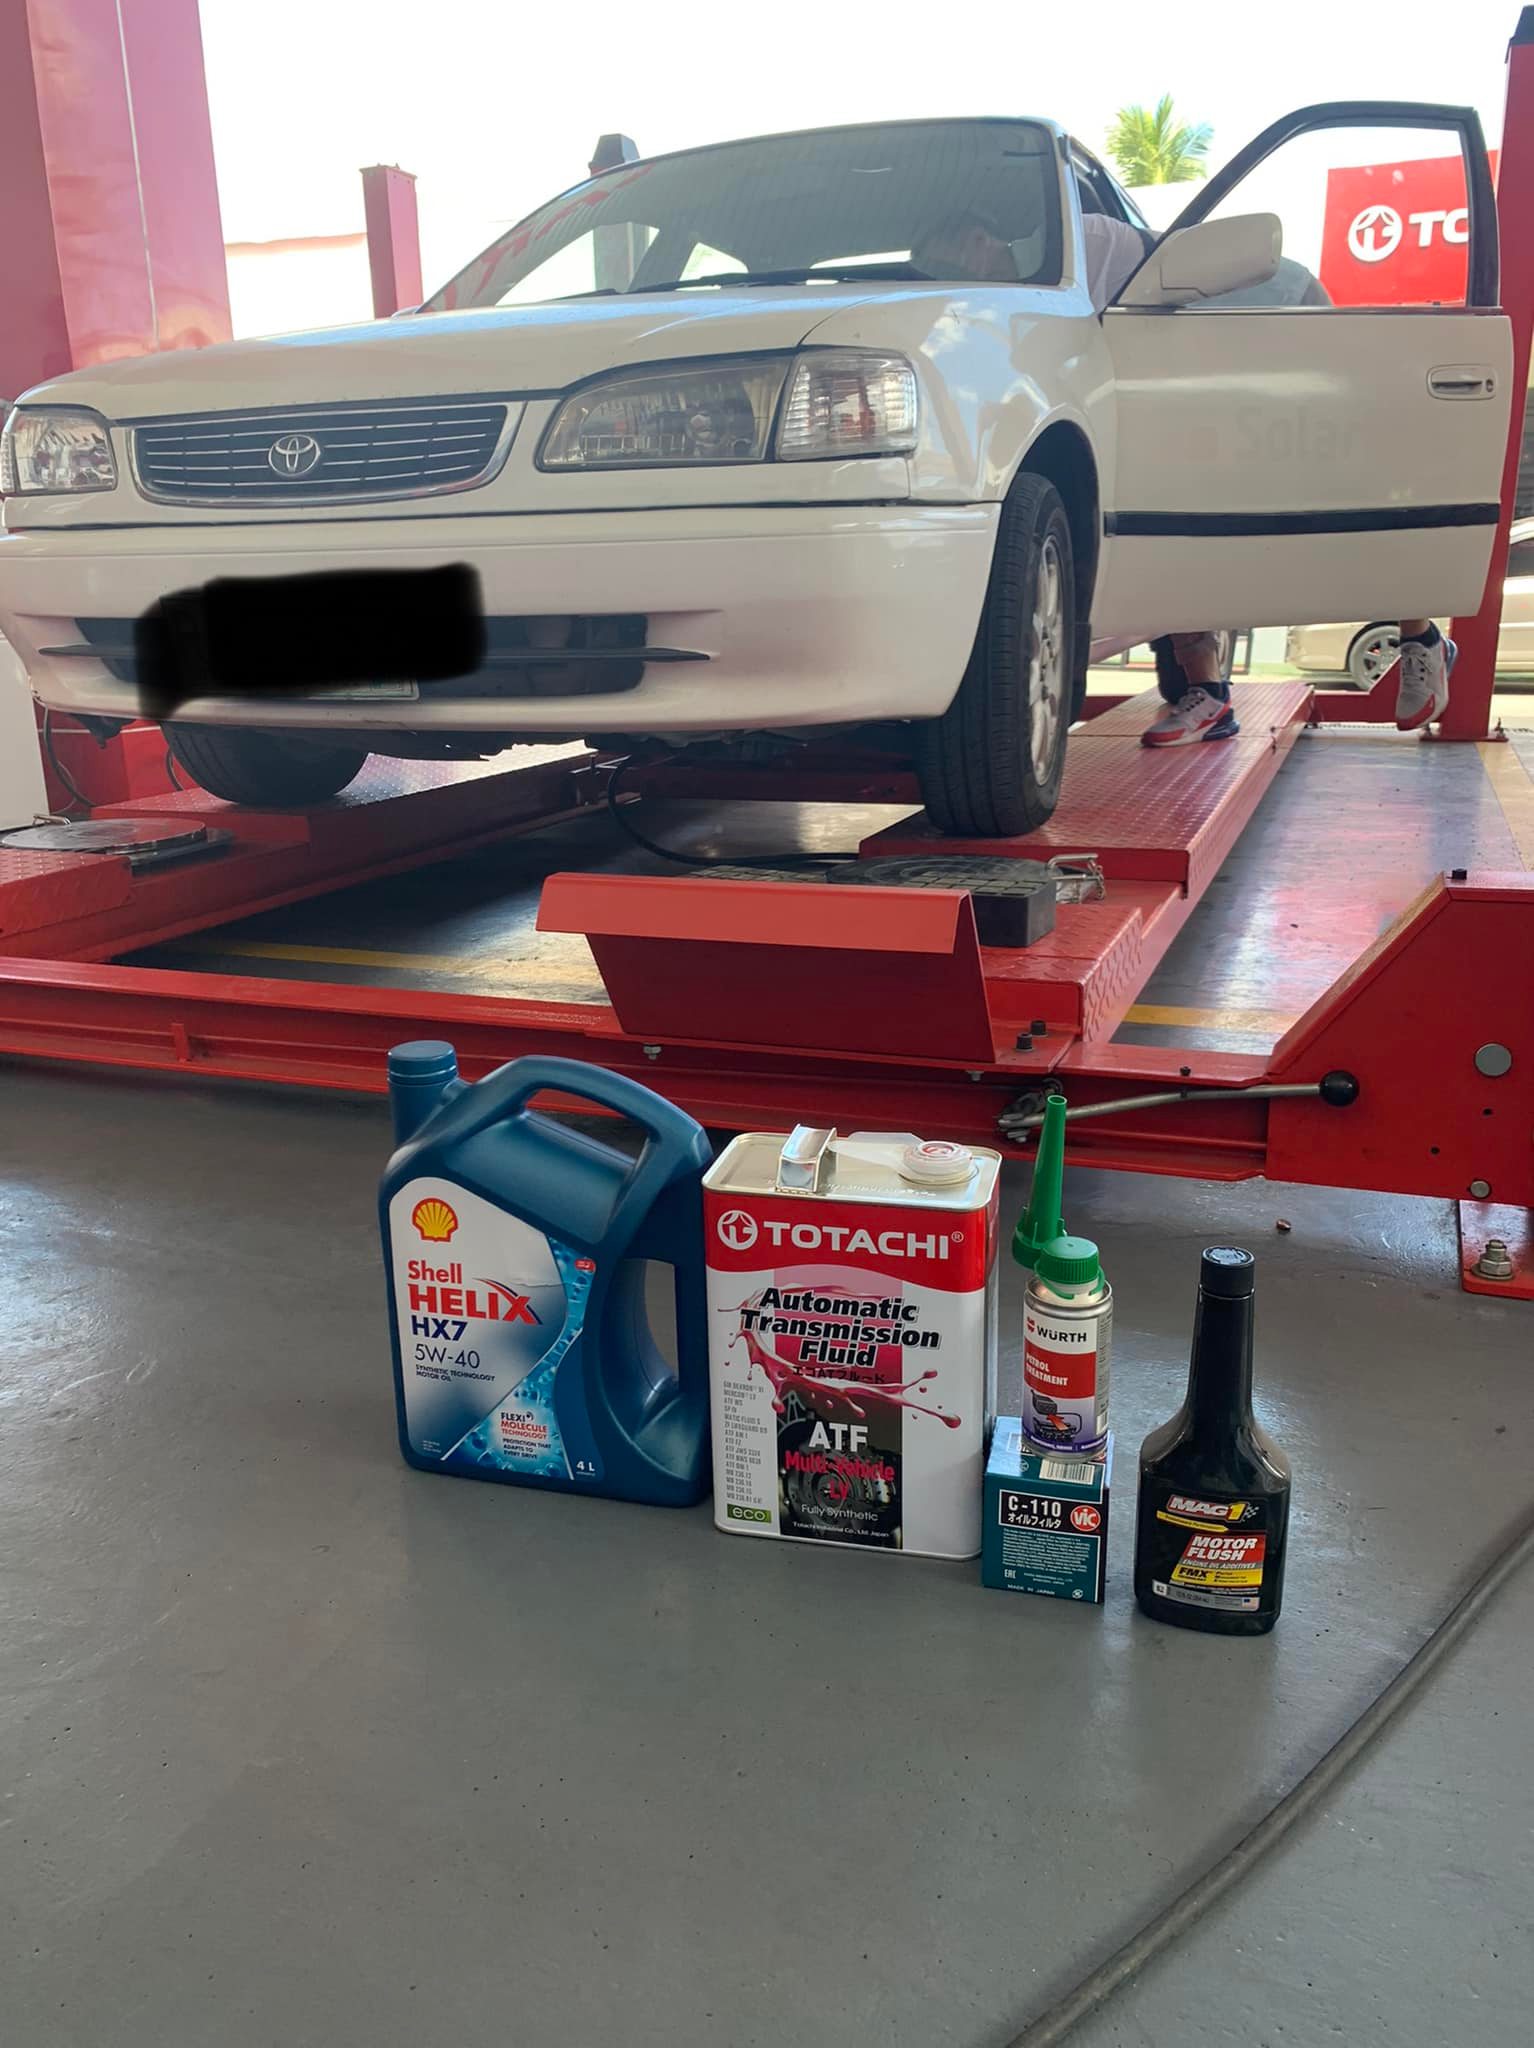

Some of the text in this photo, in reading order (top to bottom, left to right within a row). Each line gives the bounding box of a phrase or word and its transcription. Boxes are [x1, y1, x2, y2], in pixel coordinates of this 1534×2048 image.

[763, 1220, 949, 1260] TOTACHI
[407, 1260, 463, 1284] Shell
[407, 1278, 544, 1326] HELIX
[759, 1287, 919, 1322] Automatic
[411, 1315, 468, 1342] HX7
[740, 1308, 941, 1348] Transmission
[1036, 1324, 1087, 1343] WÜRTH
[414, 1343, 481, 1370] 5W-40
[799, 1340, 877, 1367] Fluid
[1026, 1362, 1069, 1386] TREATMENT
[500, 1412, 526, 1422] FLEXI
[500, 1420, 547, 1433] MOLECULE
[808, 1420, 869, 1453] ATF
[576, 1460, 596, 1472] 4 L
[732, 1507, 766, 1520] eco
[801, 1503, 879, 1521] Fully Synthetic
[1007, 1512, 1062, 1530] オイルフィルタ
[1191, 1535, 1258, 1550] MOTOR
[1186, 1547, 1246, 1561] FLUSH
[1179, 1566, 1208, 1578] FMX
